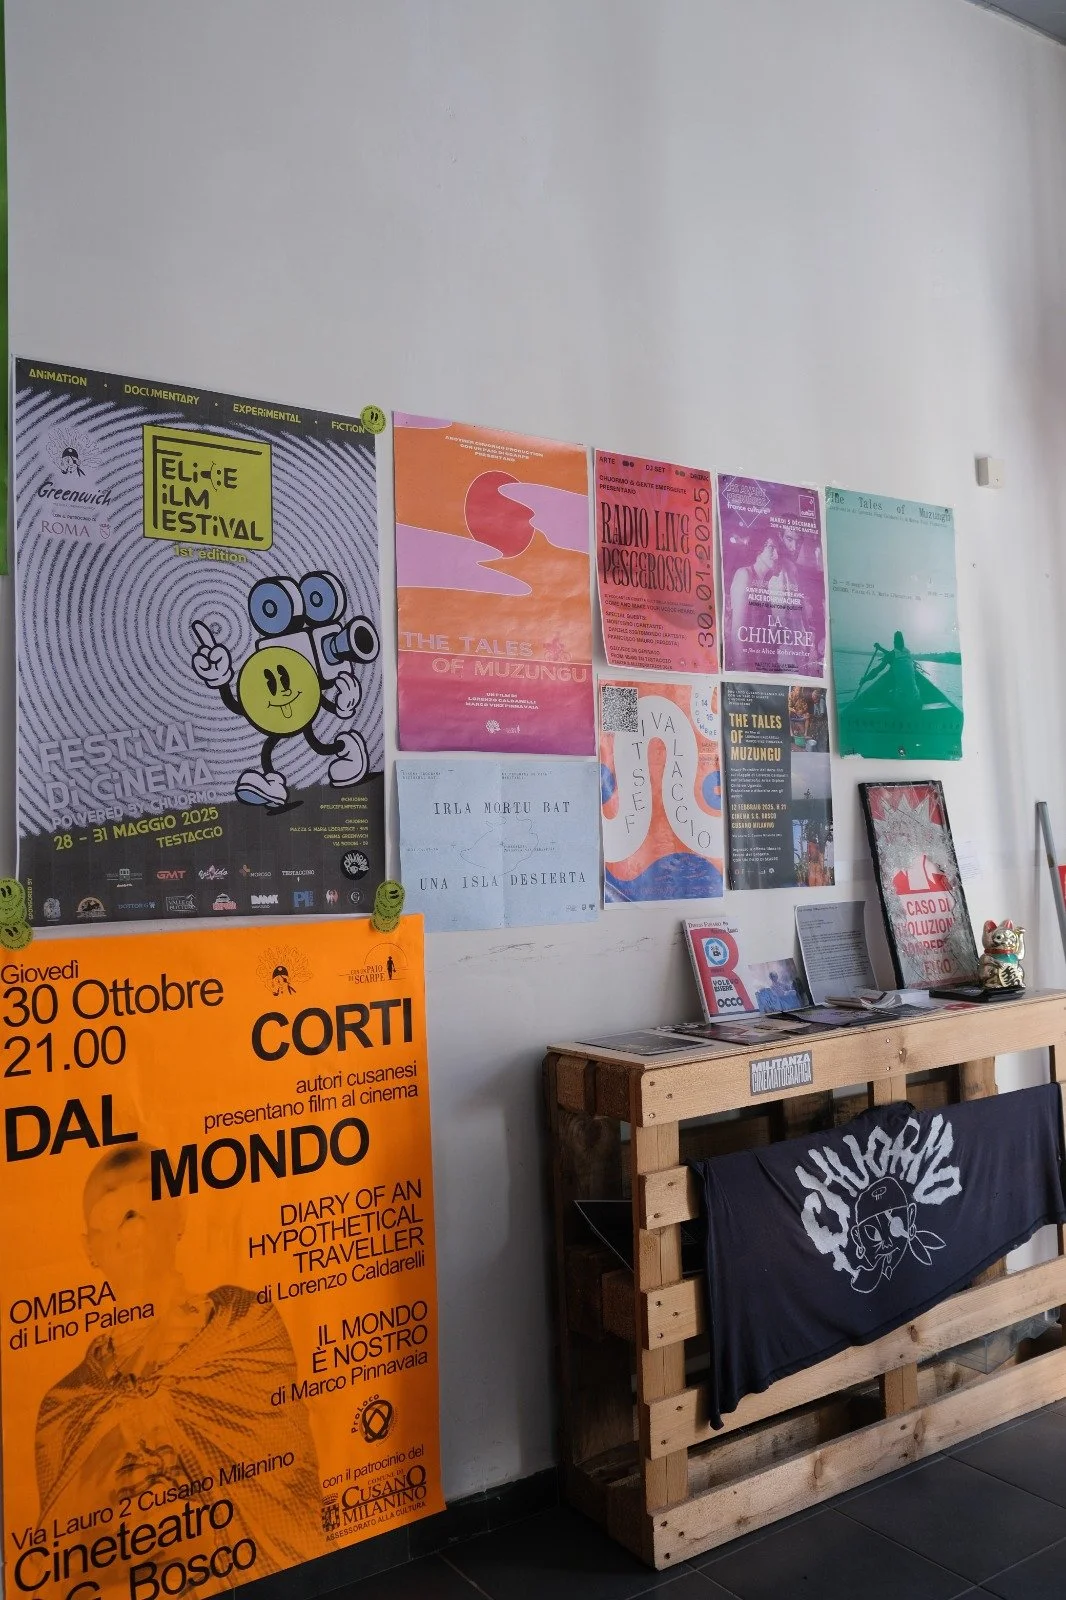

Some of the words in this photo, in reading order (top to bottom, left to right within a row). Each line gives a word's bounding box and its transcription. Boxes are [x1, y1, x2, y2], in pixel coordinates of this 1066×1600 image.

[124, 384, 200, 406] DOCUMENTARY
[599, 457, 616, 465] ARTE
[37, 481, 112, 506] Greenwich
[859, 497, 883, 511] Tales
[896, 505, 906, 515] of
[41, 520, 90, 537] ROMA
[600, 501, 650, 549] RADIO
[174, 545, 194, 558] 1st
[199, 548, 248, 563] edition
[737, 626, 814, 647] CHIMÈRE
[768, 615, 783, 627] LA
[400, 631, 450, 651] THE
[459, 636, 534, 657] TALES
[432, 657, 465, 674] OF
[474, 660, 588, 683] MUZUNGU
[729, 713, 749, 728] THE
[751, 714, 782, 729] TALES
[730, 729, 744, 744] OF
[731, 746, 781, 762] MUZUNGU
[50, 806, 124, 830] POWERED
[149, 789, 217, 811] CHUORMO
[53, 834, 73, 850] 28
[93, 828, 108, 843] 31
[182, 807, 219, 826] 2025
[434, 802, 472, 815] IRLA
[484, 801, 531, 814] MORTU
[543, 801, 570, 813] BAT
[156, 870, 186, 880] GMT
[420, 877, 449, 891] UNA
[462, 875, 499, 889] ISLA
[510, 871, 586, 886] DESIERTA
[906, 898, 937, 917] CASO
[938, 897, 951, 913] DI
[1, 960, 79, 985] Giovedì
[354, 972, 386, 985] SCARPE
[2, 983, 59, 1028] 30
[72, 973, 224, 1020] Ottobre
[251, 997, 413, 1062] CORTI
[4, 1025, 126, 1078] 21.00
[751, 1053, 811, 1074] MILITANZA
[295, 1070, 343, 1095] autori
[346, 1060, 418, 1087] cusanesi
[751, 1062, 812, 1093] CINEMATOGRAFICA
[4, 1094, 138, 1163] DAL
[204, 1100, 304, 1134] presentano
[308, 1094, 338, 1114] film
[342, 1089, 356, 1108] al
[359, 1083, 419, 1106] cinema
[150, 1117, 370, 1201] MONDO
[281, 1191, 350, 1227] DIARY
[355, 1186, 386, 1211] OF
[391, 1179, 422, 1204] AN
[249, 1204, 424, 1259] HYPOTHETICAL
[293, 1226, 425, 1274] TRAVELLER
[257, 1285, 273, 1305] di
[277, 1271, 348, 1301] Lorenzo
[351, 1252, 426, 1282] Caldarelli
[9, 1280, 117, 1325] OMBRA
[9, 1327, 28, 1350] di
[34, 1318, 79, 1345] Lino
[85, 1302, 155, 1333] Palena
[318, 1325, 337, 1347] IL
[341, 1300, 429, 1340] MONDO
[312, 1347, 328, 1374] È
[333, 1326, 429, 1369] NOSTRO
[270, 1385, 287, 1407] di
[291, 1374, 347, 1402] Marco
[351, 1350, 429, 1388] Pinnavaia
[322, 1474, 343, 1489] con
[346, 1468, 351, 1481] il
[354, 1452, 406, 1481] patrocinio
[408, 1444, 424, 1460] del
[341, 1464, 427, 1510] CUSANO
[11, 1526, 47, 1551] Via
[53, 1506, 114, 1539] Lauro
[119, 1497, 132, 1519] 2
[138, 1475, 214, 1511] Cusano
[218, 1450, 295, 1487] Milanino
[343, 1485, 427, 1527] MILANINO
[325, 1518, 377, 1542] ASSESSORATO
[377, 1511, 395, 1524] ALLA
[396, 1501, 427, 1517] CULTURA
[14, 1499, 235, 1592] Cineteatro
[130, 1538, 257, 1600] Bosco
